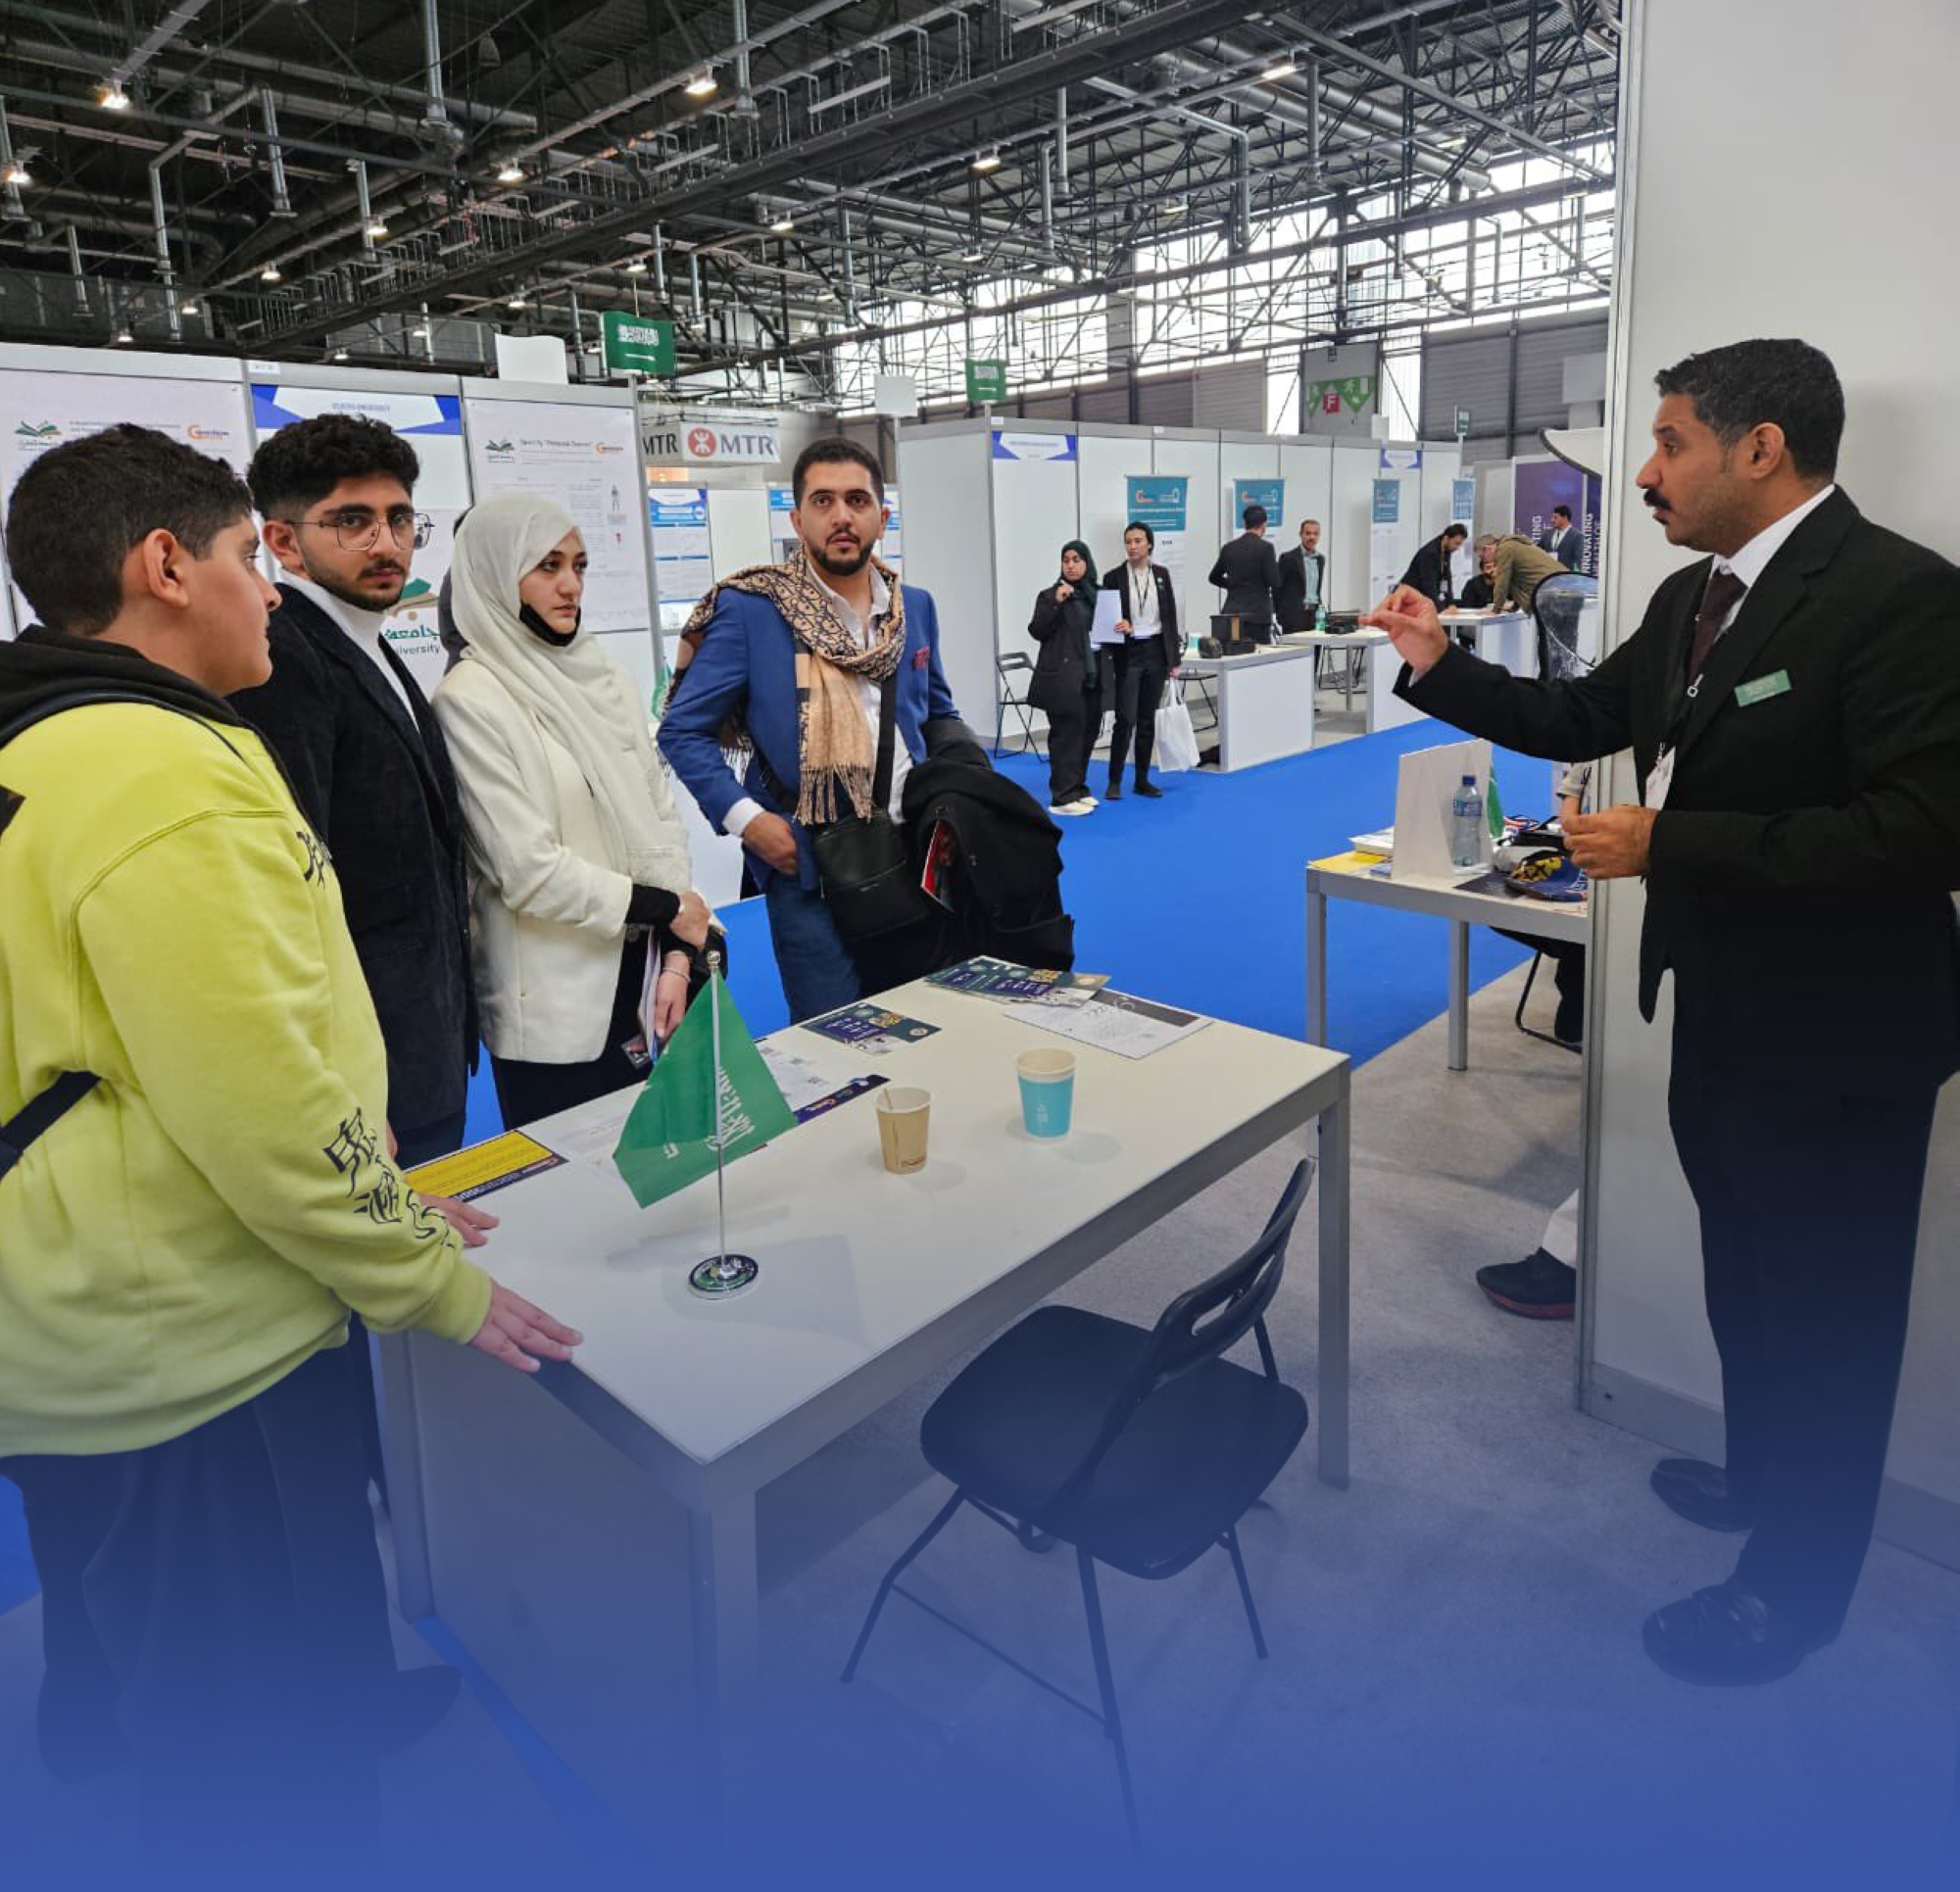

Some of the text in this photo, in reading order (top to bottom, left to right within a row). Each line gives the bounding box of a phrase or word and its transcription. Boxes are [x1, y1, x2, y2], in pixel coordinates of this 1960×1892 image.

[1327, 395, 1336, 410] F
[643, 433, 678, 455] MTR
[720, 434, 774, 456] MTR
